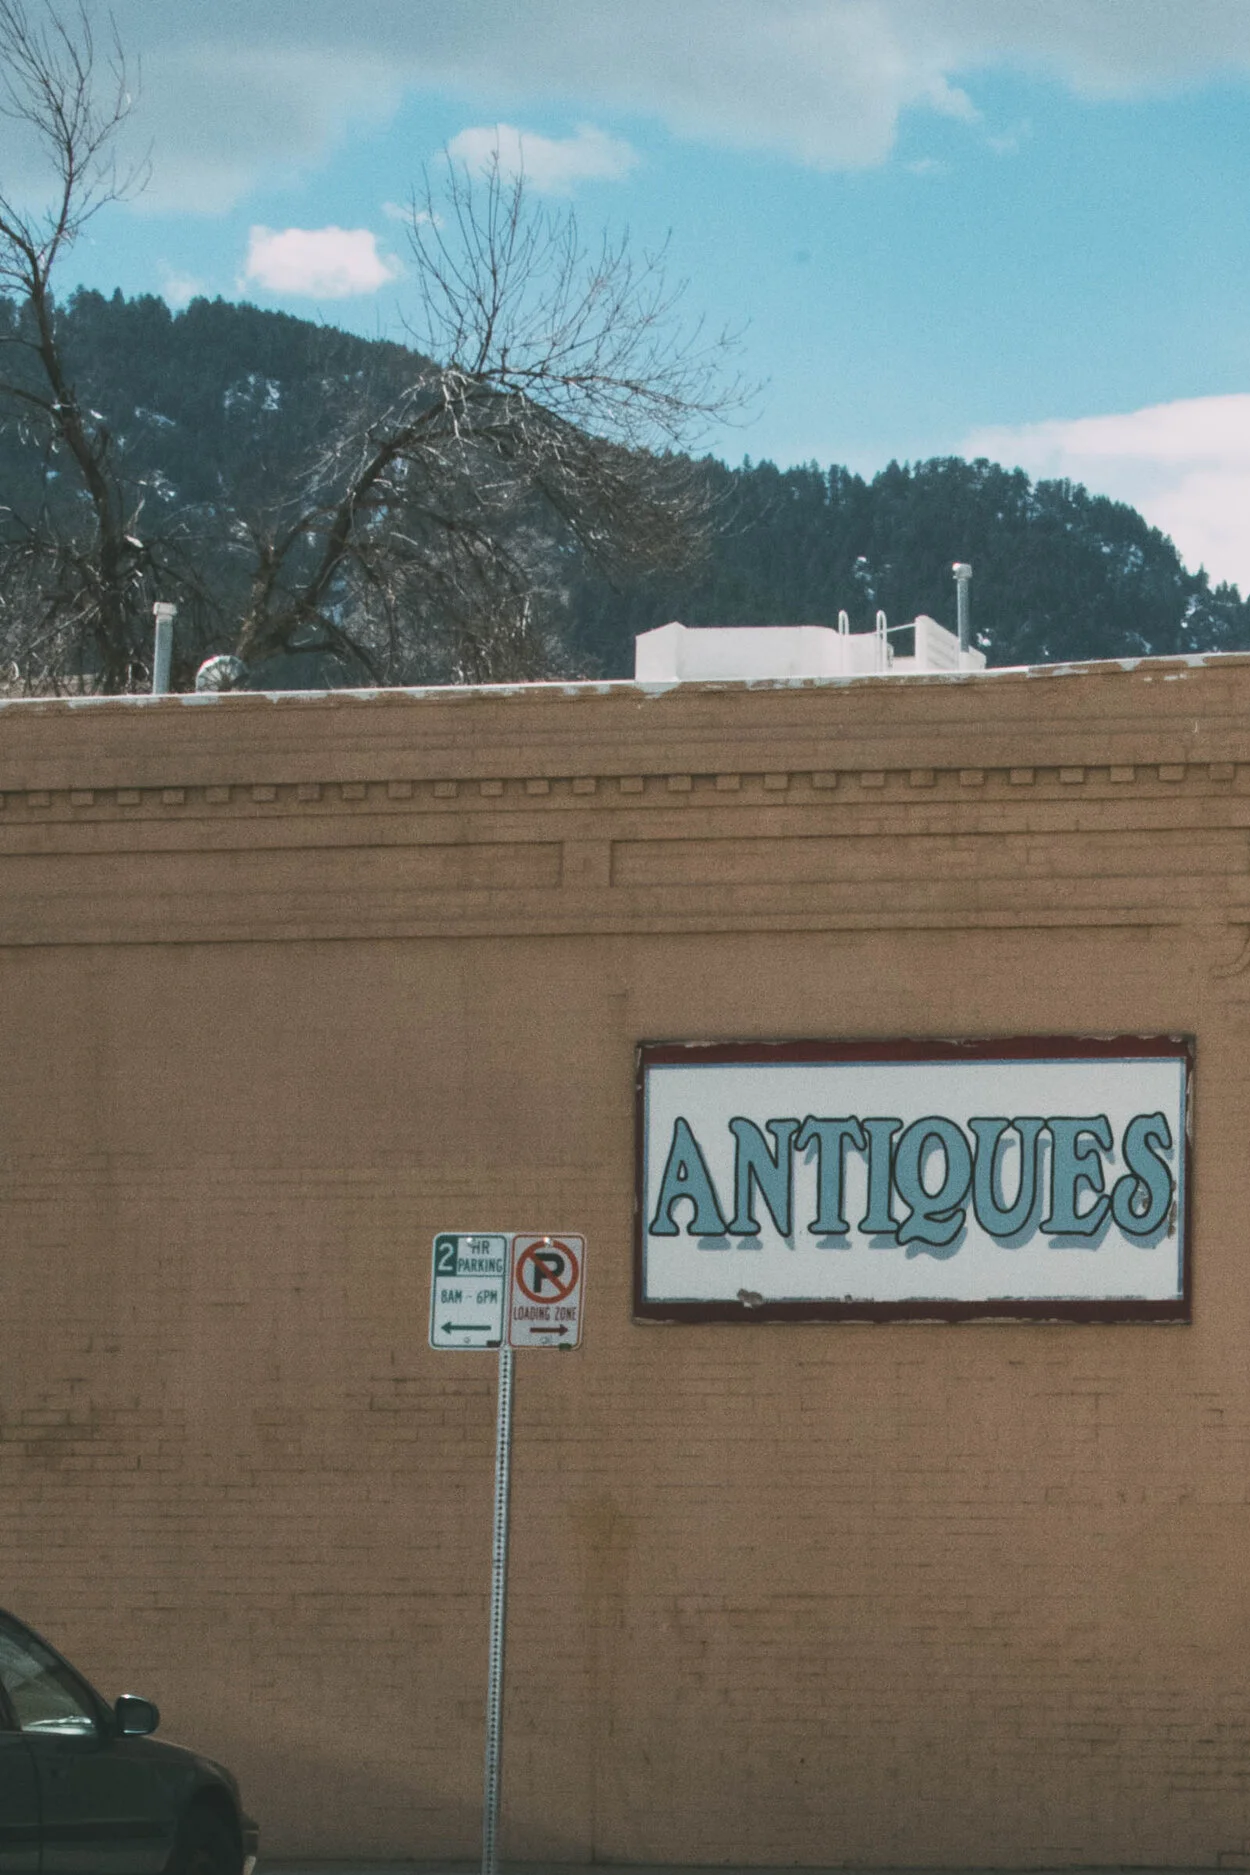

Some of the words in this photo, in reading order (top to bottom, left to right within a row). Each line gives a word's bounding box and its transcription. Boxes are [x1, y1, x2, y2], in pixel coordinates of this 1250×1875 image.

[649, 1112, 1173, 1248] ANTIQUES
[438, 1242, 454, 1271] 2
[471, 1240, 490, 1255] HR
[458, 1258, 504, 1273] PARKING
[441, 1289, 463, 1304] 8AM
[476, 1289, 498, 1304] 6PM
[513, 1306, 551, 1321] LOADING
[554, 1306, 577, 1321] ZONE
